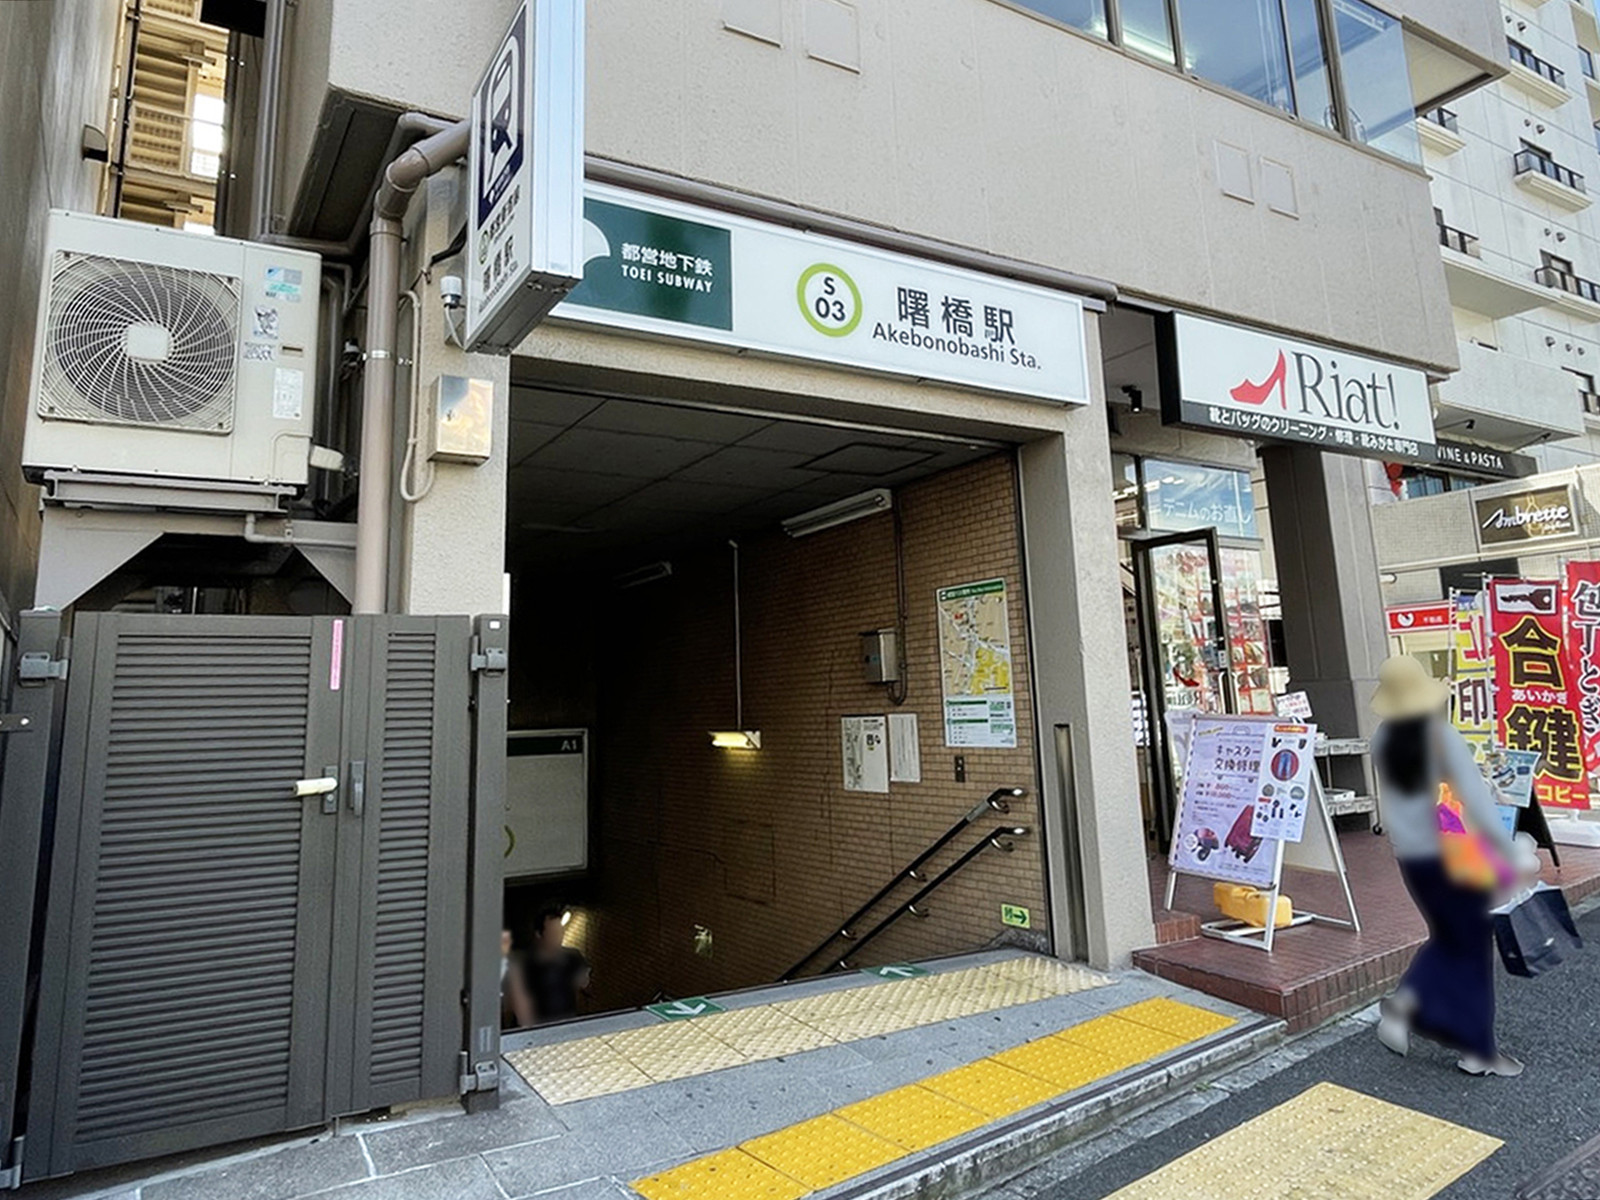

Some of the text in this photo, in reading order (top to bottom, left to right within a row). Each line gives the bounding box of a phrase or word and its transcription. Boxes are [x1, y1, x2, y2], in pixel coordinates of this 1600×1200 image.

[621, 242, 713, 277] 都営地下鉄
[621, 264, 713, 293] TOEI SUBWAY
[823, 276, 836, 296] S
[815, 297, 846, 322] 03
[896, 286, 1016, 346] 曙橋駅
[872, 322, 1042, 370] Akebonobashi Sta.
[1291, 351, 1400, 431] Riat!
[1471, 451, 1505, 470] PASTA
[561, 740, 577, 751] A1
[1537, 784, 1586, 804] コピー
